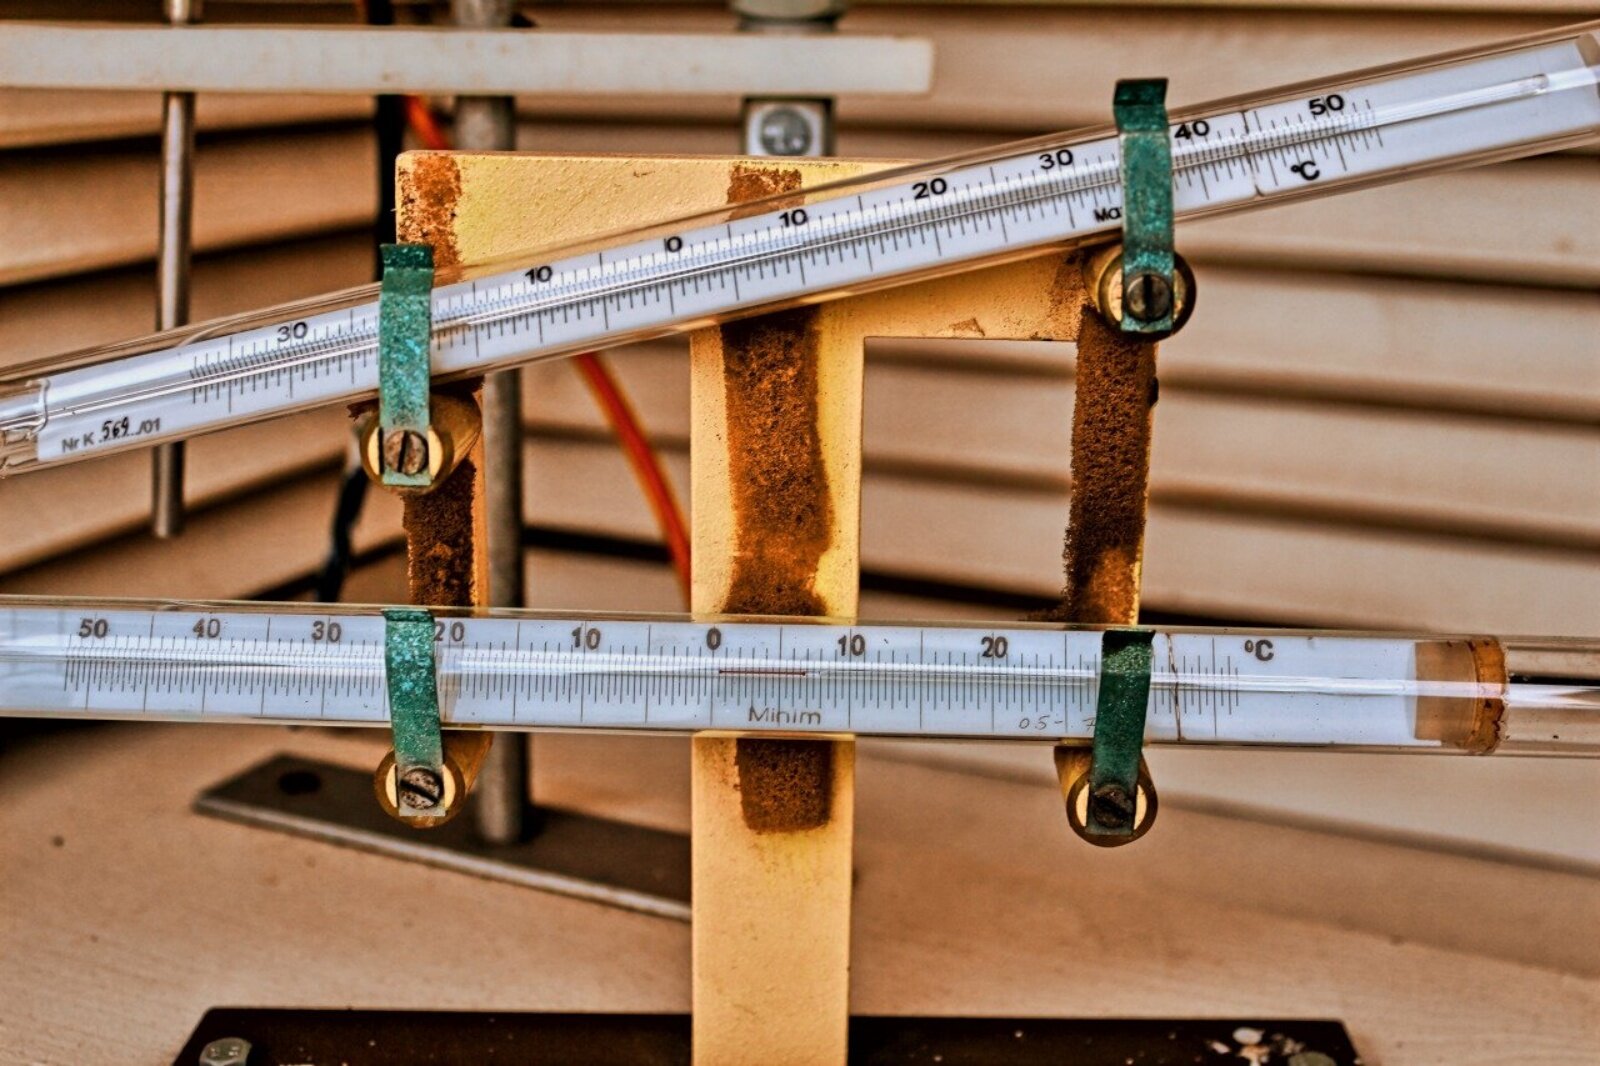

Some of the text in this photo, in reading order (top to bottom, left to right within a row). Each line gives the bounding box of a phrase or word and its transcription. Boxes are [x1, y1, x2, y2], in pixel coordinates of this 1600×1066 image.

[276, 94, 1345, 344] 30 10 0 10 20 30 40 50
[61, 438, 79, 453] Nr
[83, 431, 94, 446] K
[79, 618, 1009, 659] 50 40 30 20 10 0 10 20
[748, 704, 822, 726] Minim
